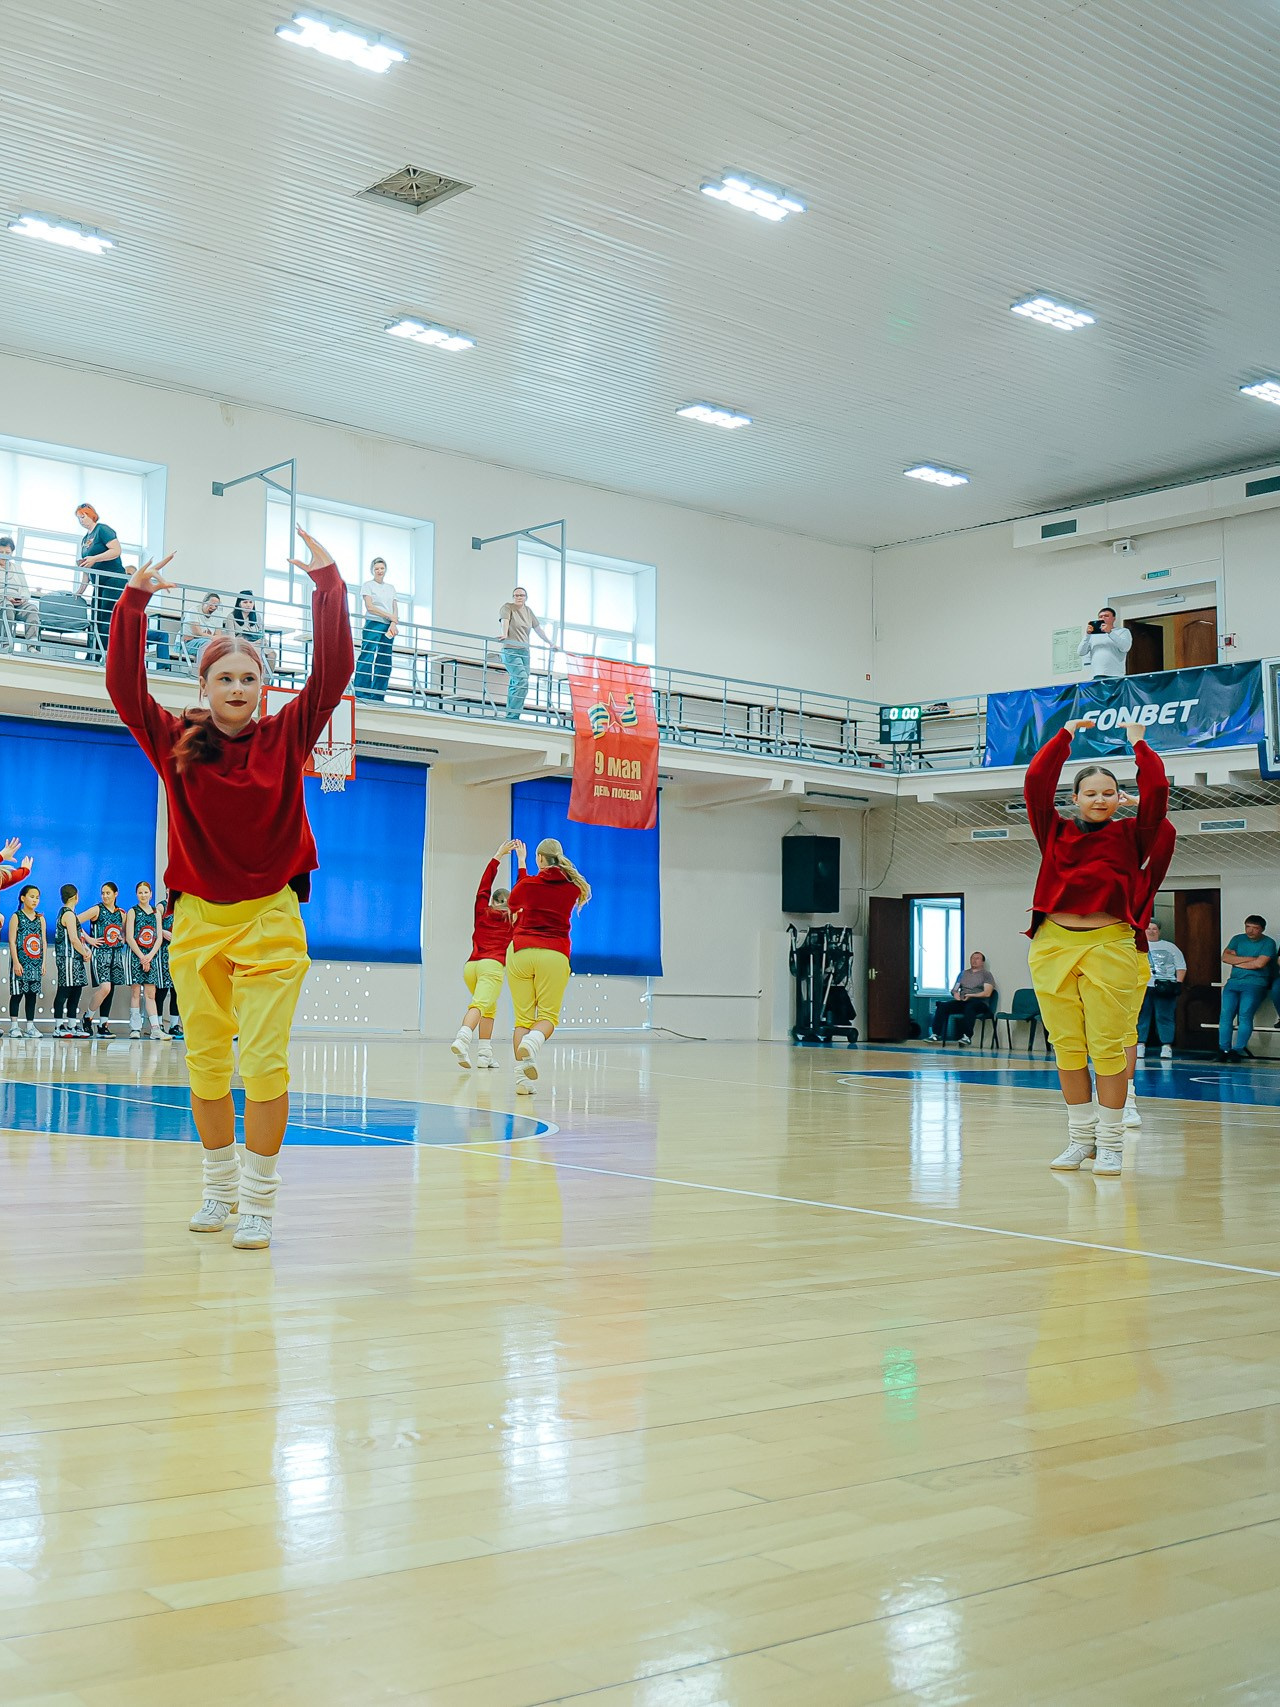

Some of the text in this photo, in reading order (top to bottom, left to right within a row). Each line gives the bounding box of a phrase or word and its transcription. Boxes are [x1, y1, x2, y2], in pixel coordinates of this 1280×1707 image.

[1079, 699, 1199, 732] FONBET
[594, 750, 605, 775] 9
[611, 787, 642, 801] ПОБЕДЫ
